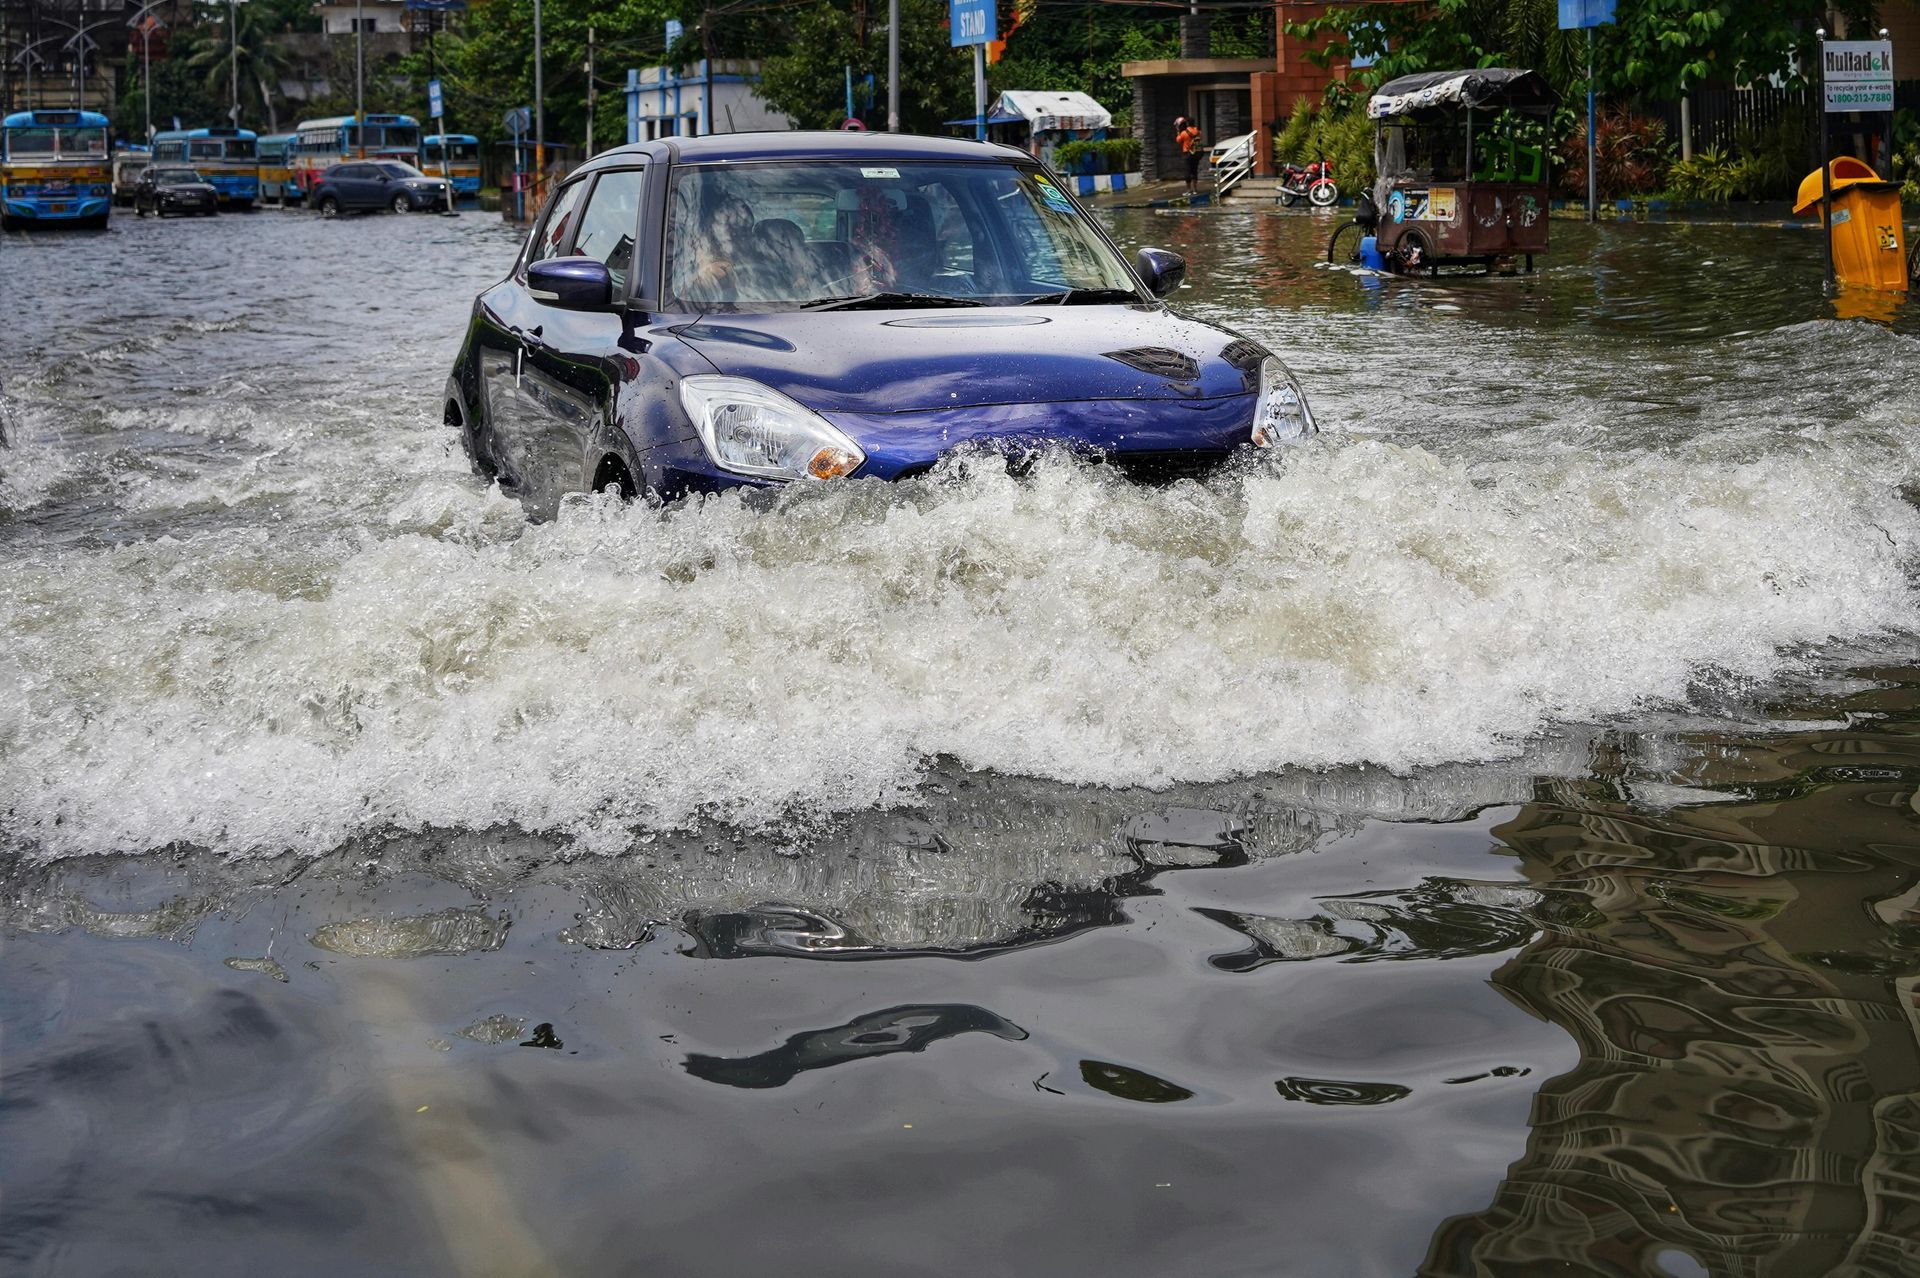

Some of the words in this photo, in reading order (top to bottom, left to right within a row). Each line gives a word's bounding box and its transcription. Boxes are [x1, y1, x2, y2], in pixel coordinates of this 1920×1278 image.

[961, 9, 985, 38] STAND
[1826, 51, 1890, 71] Hulladek
[1834, 84, 1853, 92] recycle
[1834, 93, 1891, 103] 1800-212-7880
